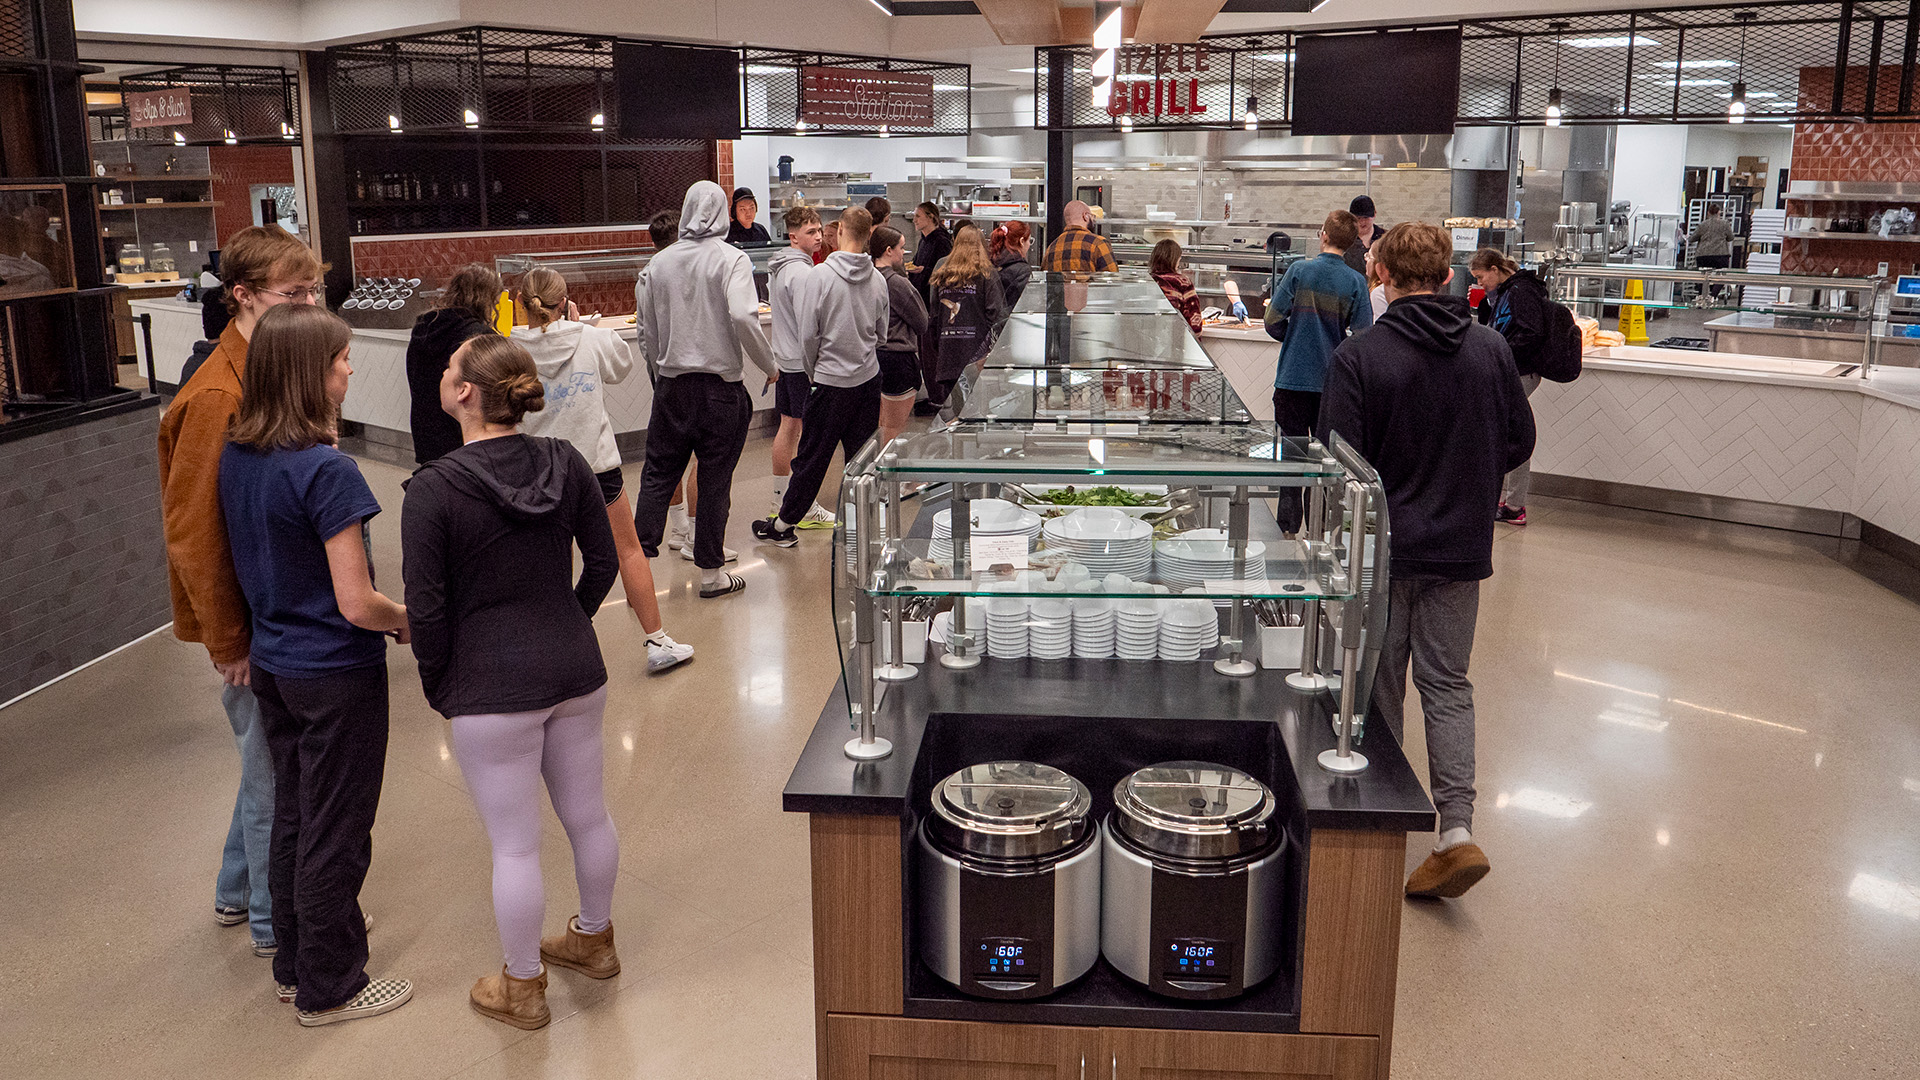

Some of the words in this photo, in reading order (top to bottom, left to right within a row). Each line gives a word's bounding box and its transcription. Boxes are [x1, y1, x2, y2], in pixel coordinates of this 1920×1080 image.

[143, 98, 158, 124] Sips
[167, 95, 187, 117] Such
[844, 83, 918, 121] Station
[1107, 78, 1207, 117] GRILL
[995, 945, 1023, 957] 160F
[1185, 946, 1214, 957] 160F
